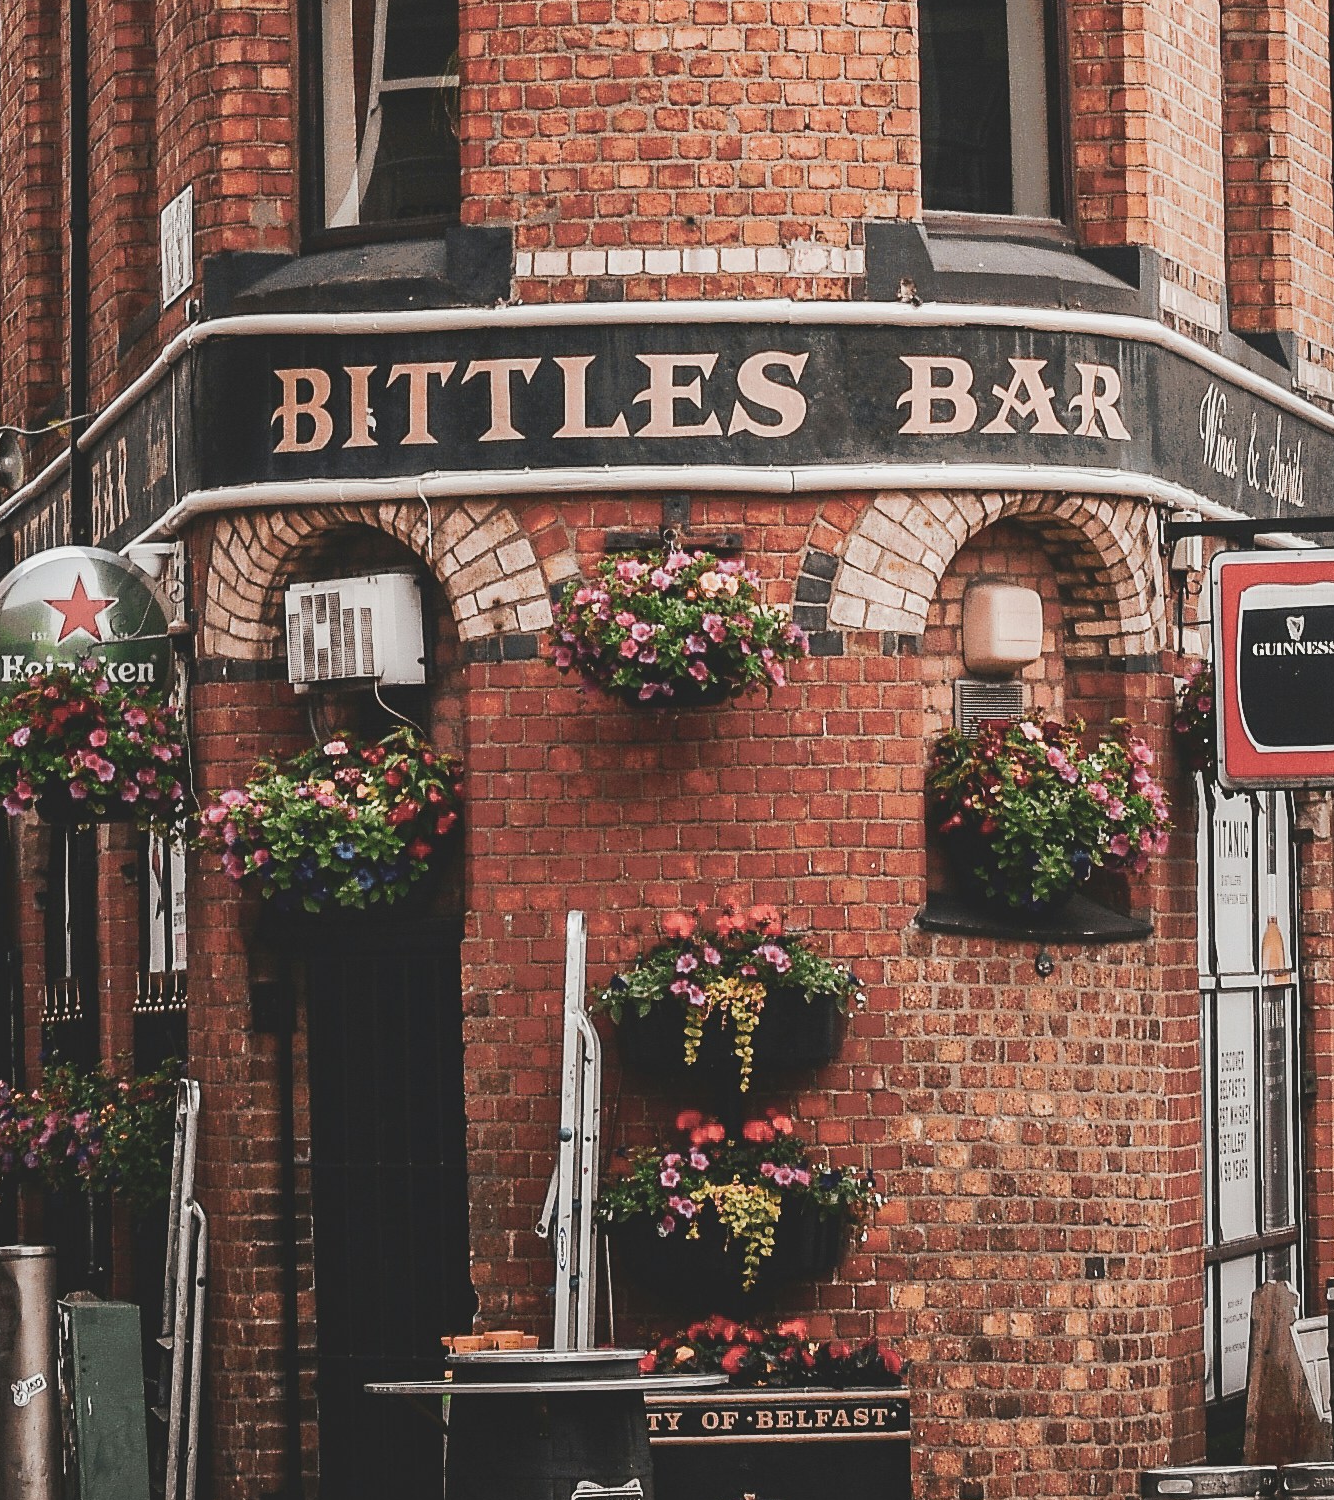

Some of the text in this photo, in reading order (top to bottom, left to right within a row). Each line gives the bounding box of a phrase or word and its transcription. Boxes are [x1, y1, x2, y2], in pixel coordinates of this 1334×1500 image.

[270, 350, 813, 454] BITTLES
[896, 355, 1134, 442] BAR
[91, 436, 131, 549] BAR
[1, 654, 156, 683] Heiken
[645, 1408, 889, 1431] TY OF BELFAST
